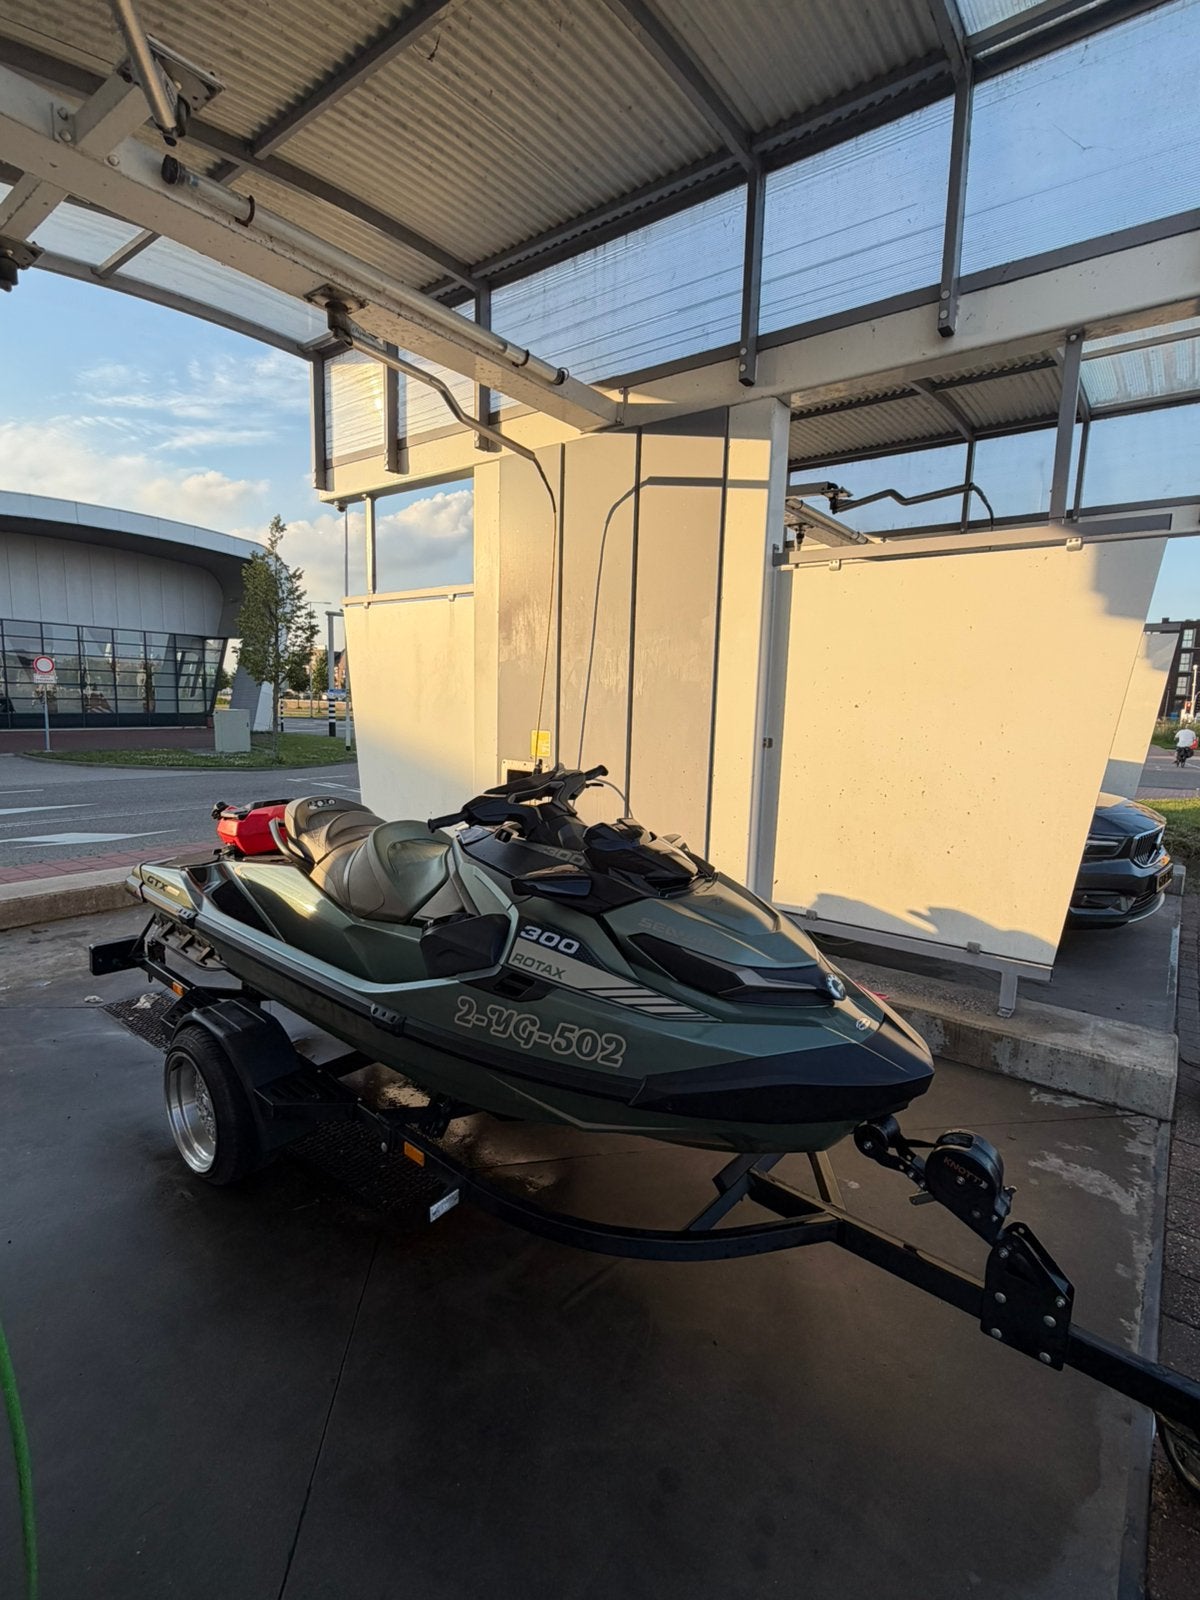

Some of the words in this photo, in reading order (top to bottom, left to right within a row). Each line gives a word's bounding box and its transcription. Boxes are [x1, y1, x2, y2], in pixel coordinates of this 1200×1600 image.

[147, 875, 168, 892] GTX
[519, 925, 581, 955] 300
[511, 952, 567, 980] ROTAX
[454, 995, 627, 1069] 2-YG-502
[943, 1156, 983, 1183] KNOTT
